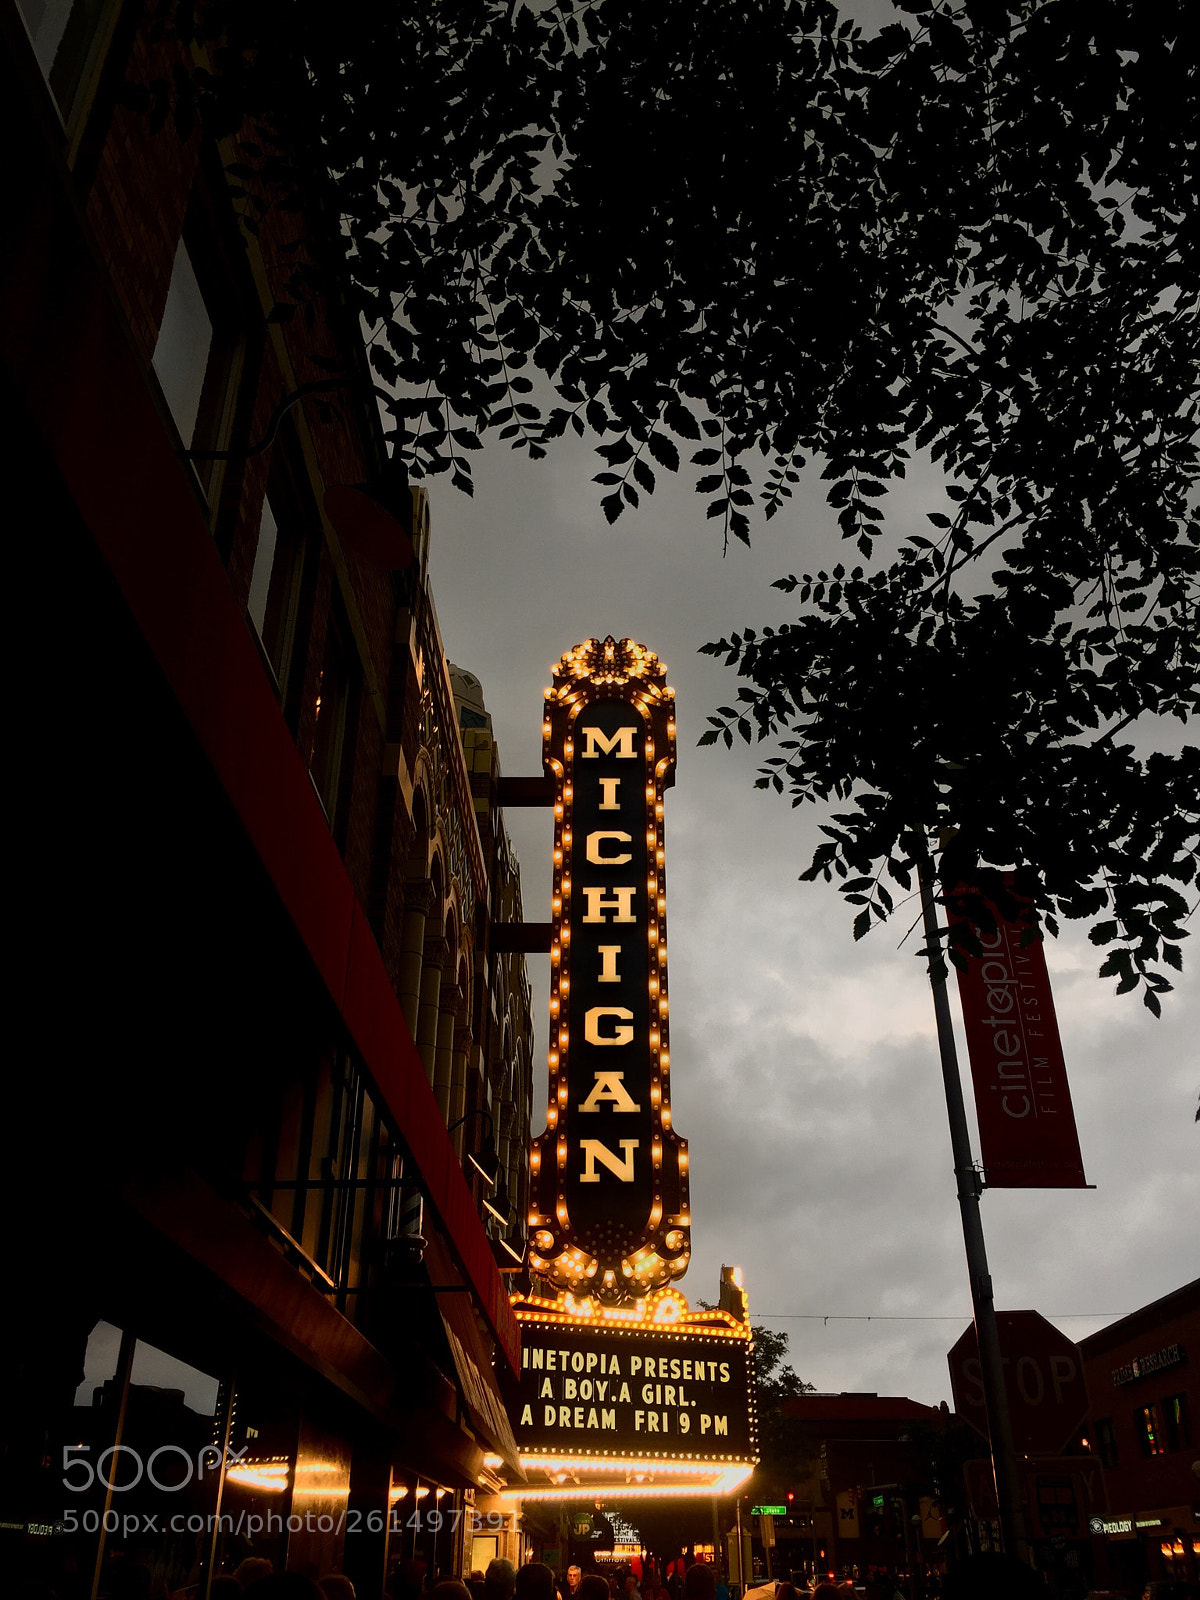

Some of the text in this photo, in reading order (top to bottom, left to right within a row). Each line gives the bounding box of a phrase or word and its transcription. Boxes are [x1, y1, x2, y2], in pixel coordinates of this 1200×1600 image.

[577, 725, 642, 1183] MICHIGAN
[1033, 1057, 1057, 1114] FILM
[522, 1347, 731, 1383] INETOPIA PRESENTS
[540, 1377, 554, 1399] A
[641, 1383, 697, 1407] GIRL.
[520, 1404, 729, 1436] A DREAM FRI 9 PM
[841, 1508, 854, 1520] M
